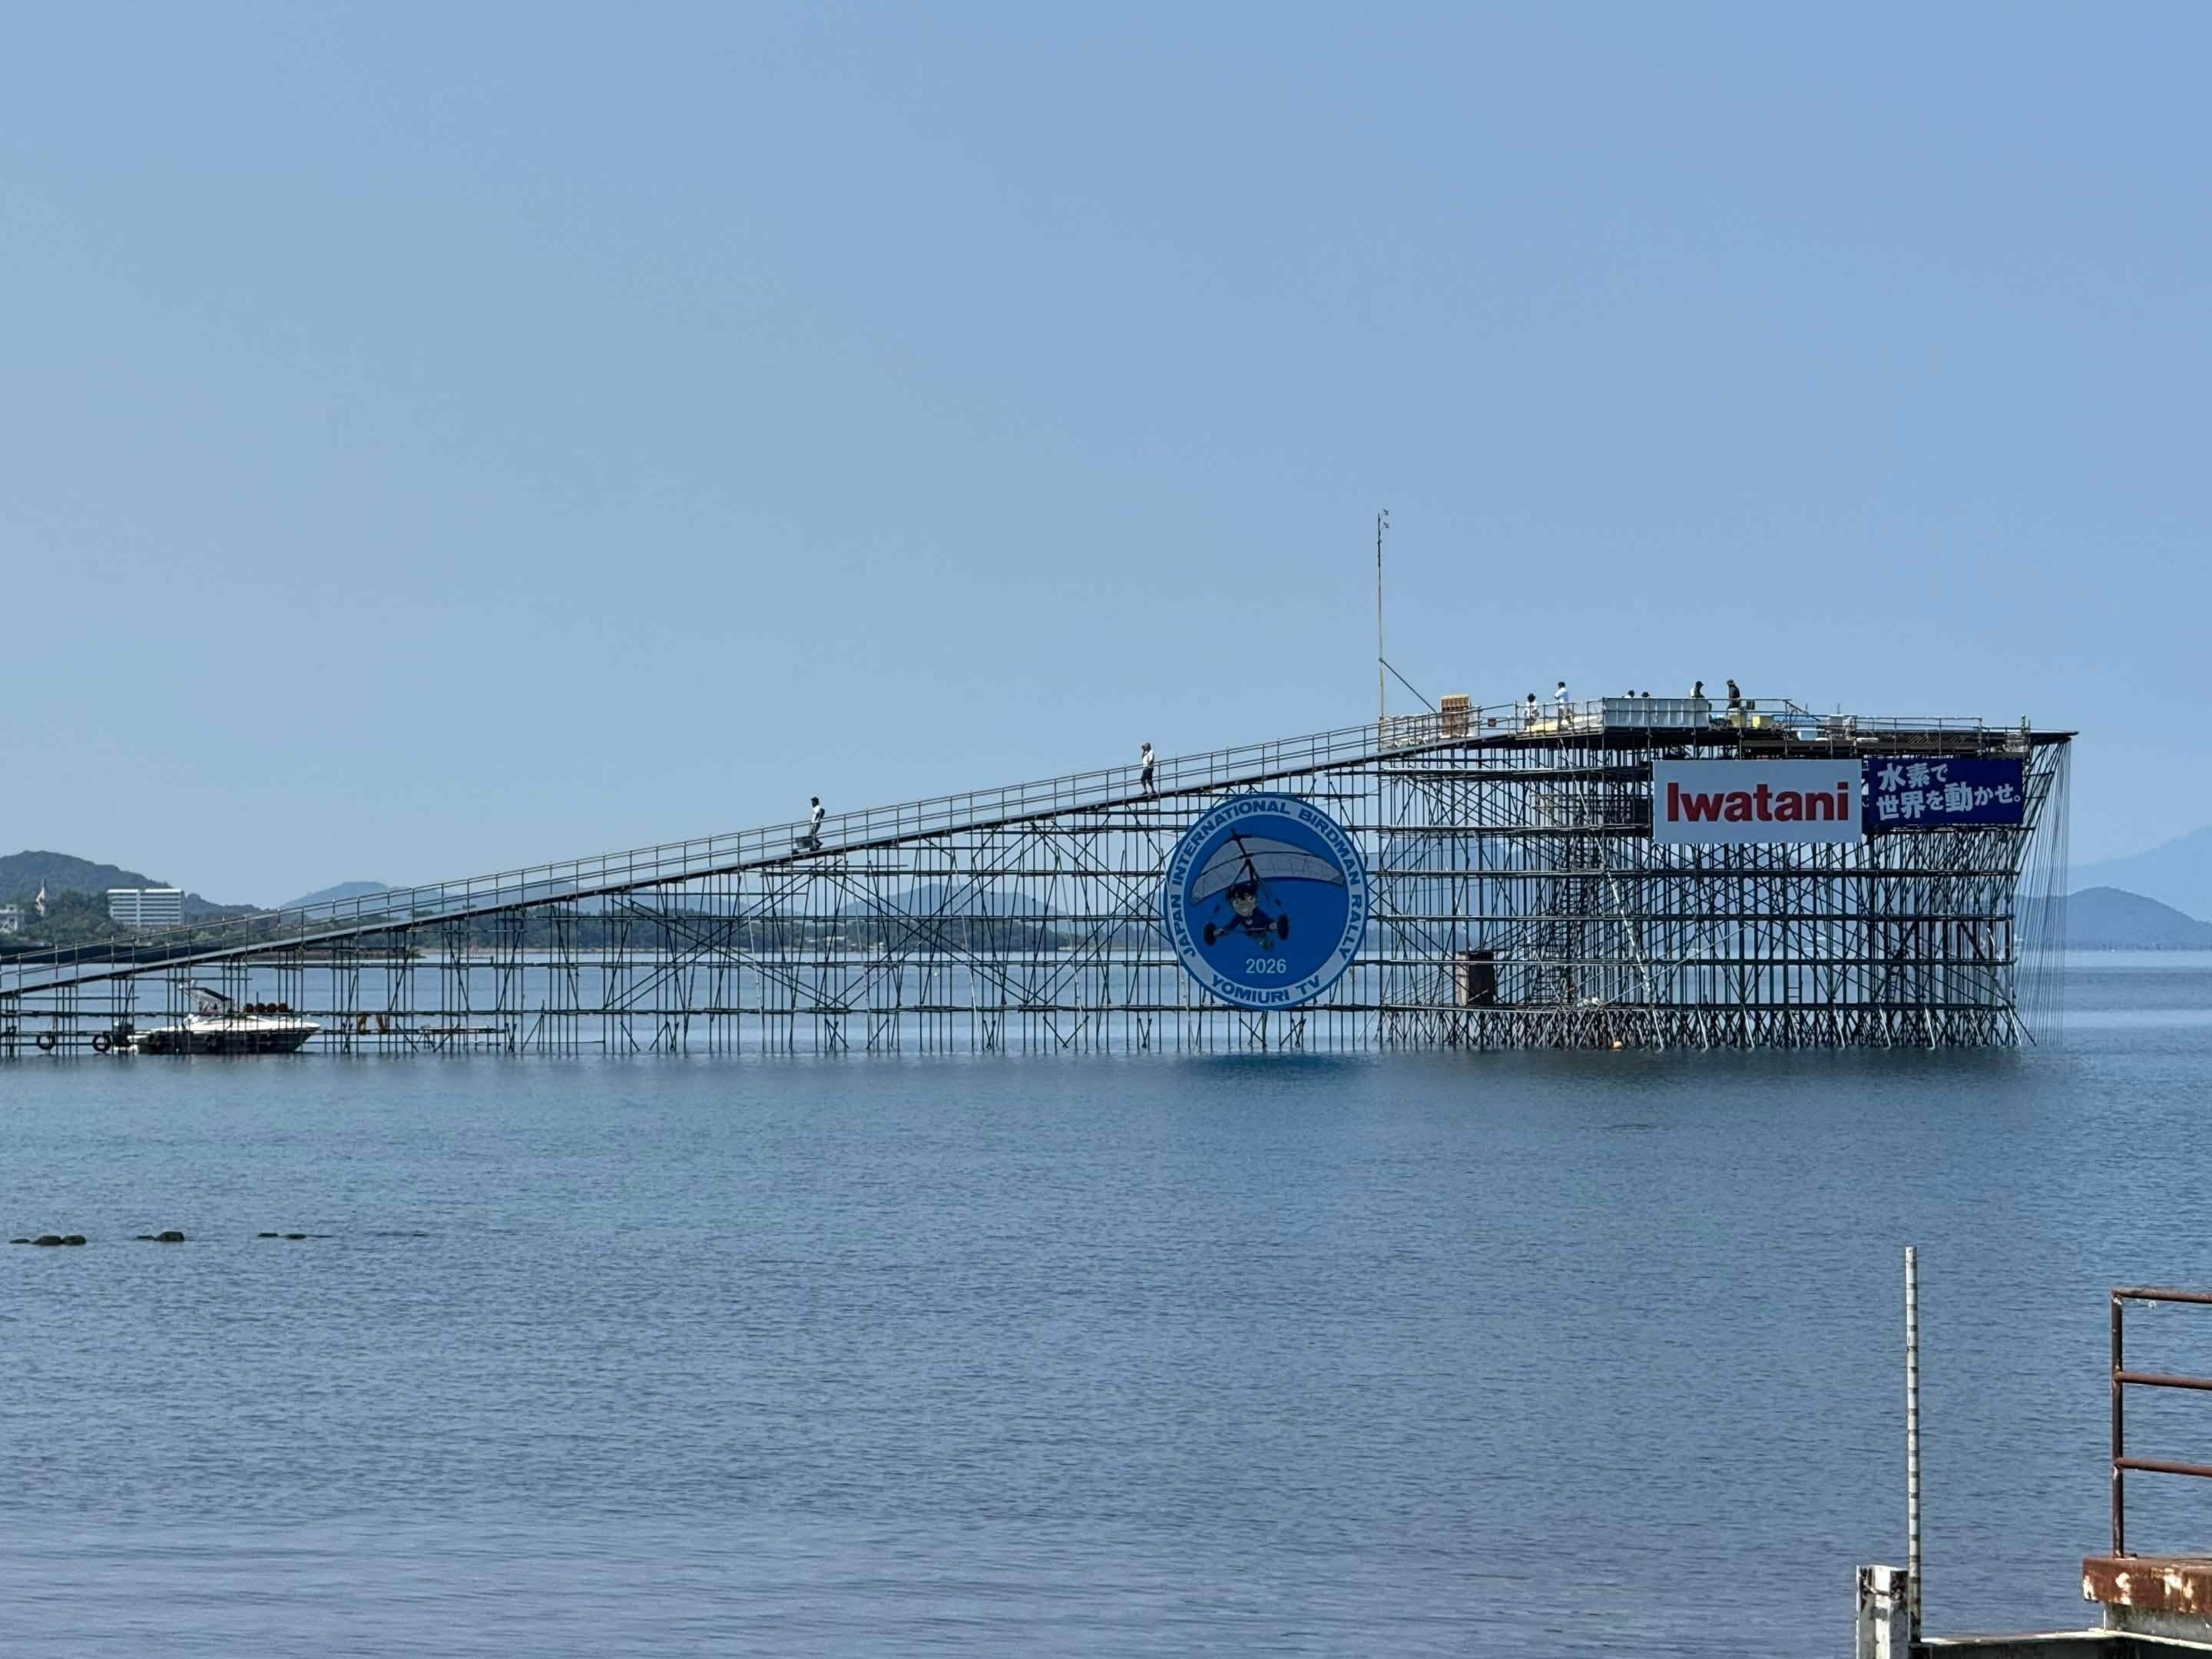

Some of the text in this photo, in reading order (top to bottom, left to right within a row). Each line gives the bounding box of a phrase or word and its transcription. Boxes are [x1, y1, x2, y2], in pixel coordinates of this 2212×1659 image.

[1877, 762, 1949, 792] 水素で
[1667, 781, 1849, 822] Iwatani
[1876, 781, 2022, 820] 世界を動かせ。
[1171, 800, 1362, 959] JAPAN INTERNATIONAL BIRDMAN RALLY
[1245, 958, 1286, 974] 2026
[1211, 974, 1320, 1004] YOMIURI TV
